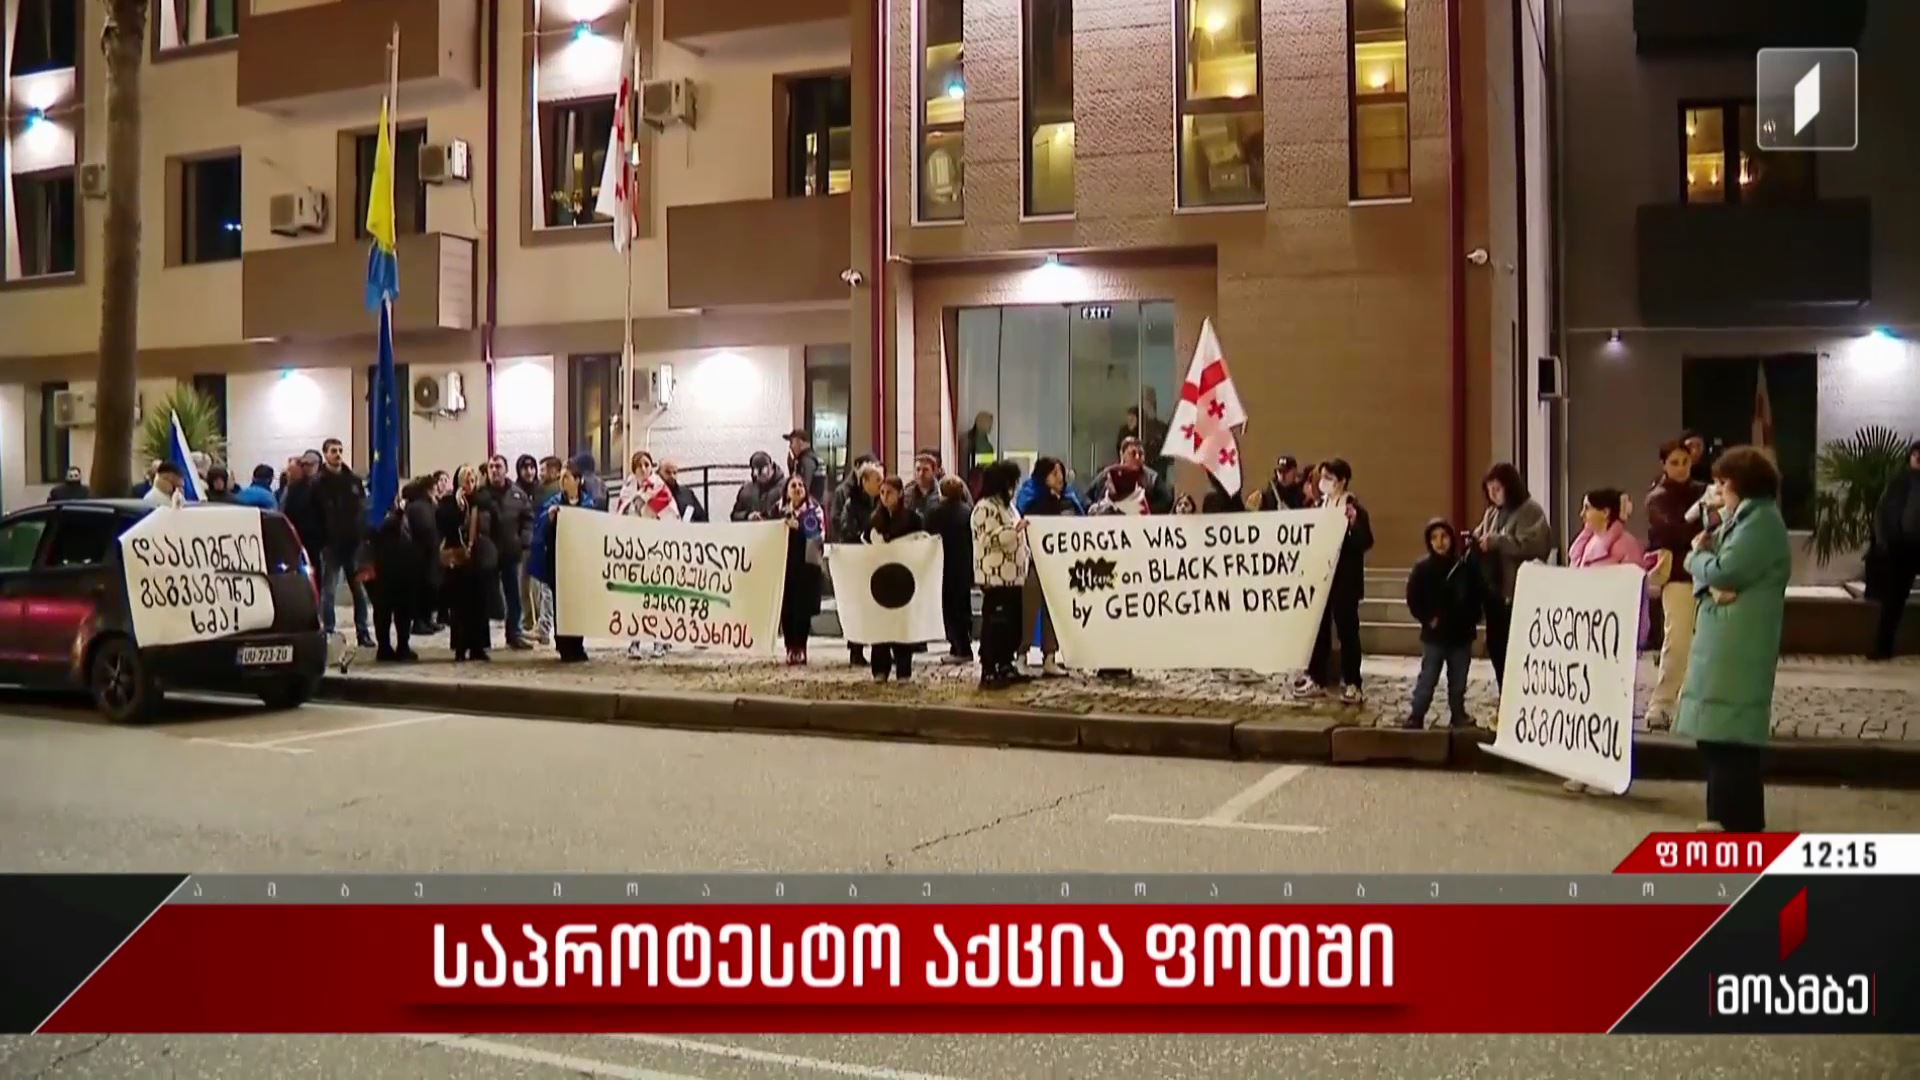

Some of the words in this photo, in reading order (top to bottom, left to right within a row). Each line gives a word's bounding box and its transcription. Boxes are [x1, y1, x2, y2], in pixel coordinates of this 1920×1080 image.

[1081, 305, 1111, 319] EXIT
[603, 535, 752, 572] საქართველოს
[1042, 530, 1131, 553] GEORGIA
[1144, 527, 1187, 549] WAS
[1204, 524, 1260, 546] SOLD
[1277, 524, 1315, 545] OUT
[602, 562, 732, 594] კონსტიტუცია
[1122, 572, 1142, 584] on
[1149, 555, 1218, 583] BLACK
[191, 607, 240, 633] ხმა!
[689, 598, 709, 620] 78
[1073, 600, 1092, 628] by
[1106, 590, 1230, 619] GEORGIAN
[609, 610, 753, 648] გადაგვახიეს
[1529, 606, 1619, 663] გადმოდი
[1522, 653, 1591, 704] ქვეყანა
[1515, 706, 1622, 761] გაგიყიდეს
